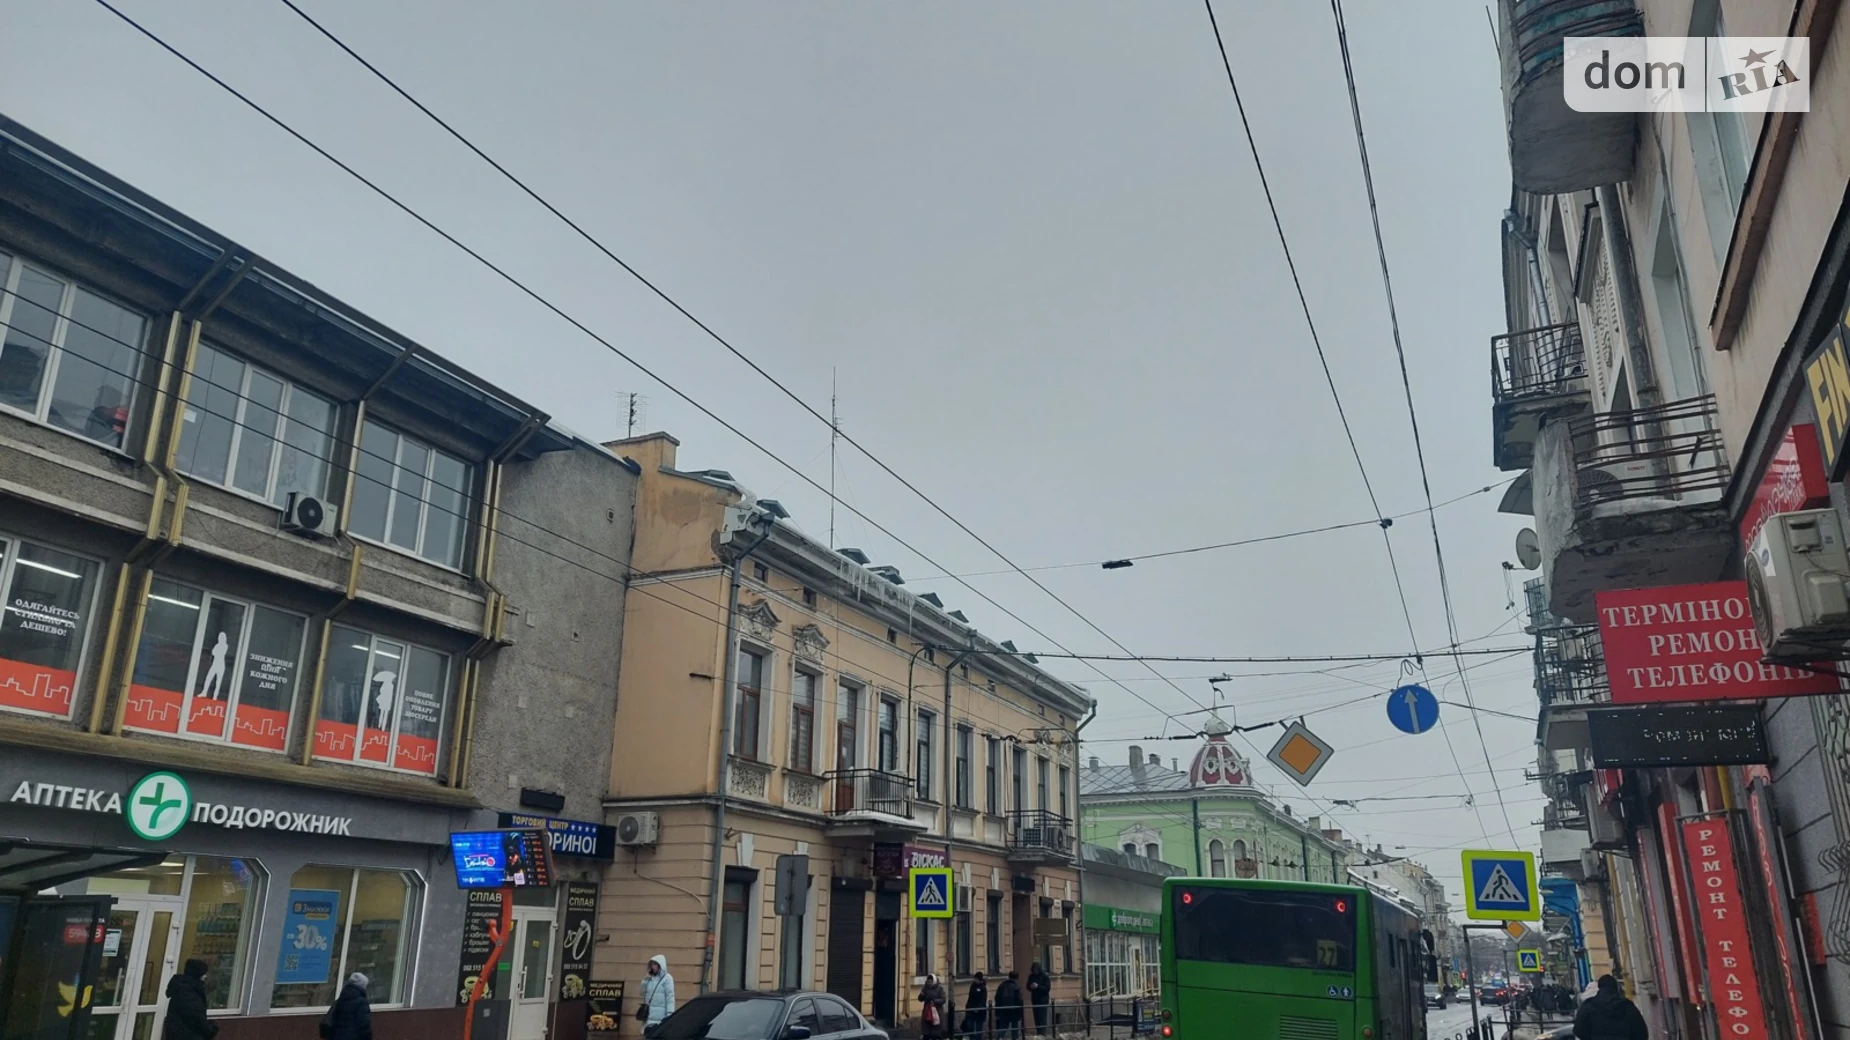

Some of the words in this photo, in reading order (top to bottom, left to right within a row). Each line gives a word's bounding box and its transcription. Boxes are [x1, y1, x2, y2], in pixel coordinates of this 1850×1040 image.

[15, 598, 80, 620] ОДЯГАЙТЕСЬ
[1602, 596, 1752, 628] ТЕРМІНО
[19, 620, 67, 637] ДЕШЕВО!
[1647, 628, 1761, 657] РЕМОН
[10, 781, 122, 814] АПТЕКА
[193, 802, 353, 836] ПОДОРОЖНИК
[511, 815, 547, 828] ТОРГОВИЙ
[548, 820, 569, 830] ЦЕНТР
[1698, 829, 1728, 921] РЕМОНТ
[470, 891, 503, 903] СПЛАВ
[568, 896, 595, 907] СПЛАВ
[589, 989, 622, 998] СПЛАВ
[1718, 940, 1752, 1040] ТЕЛЕФО
